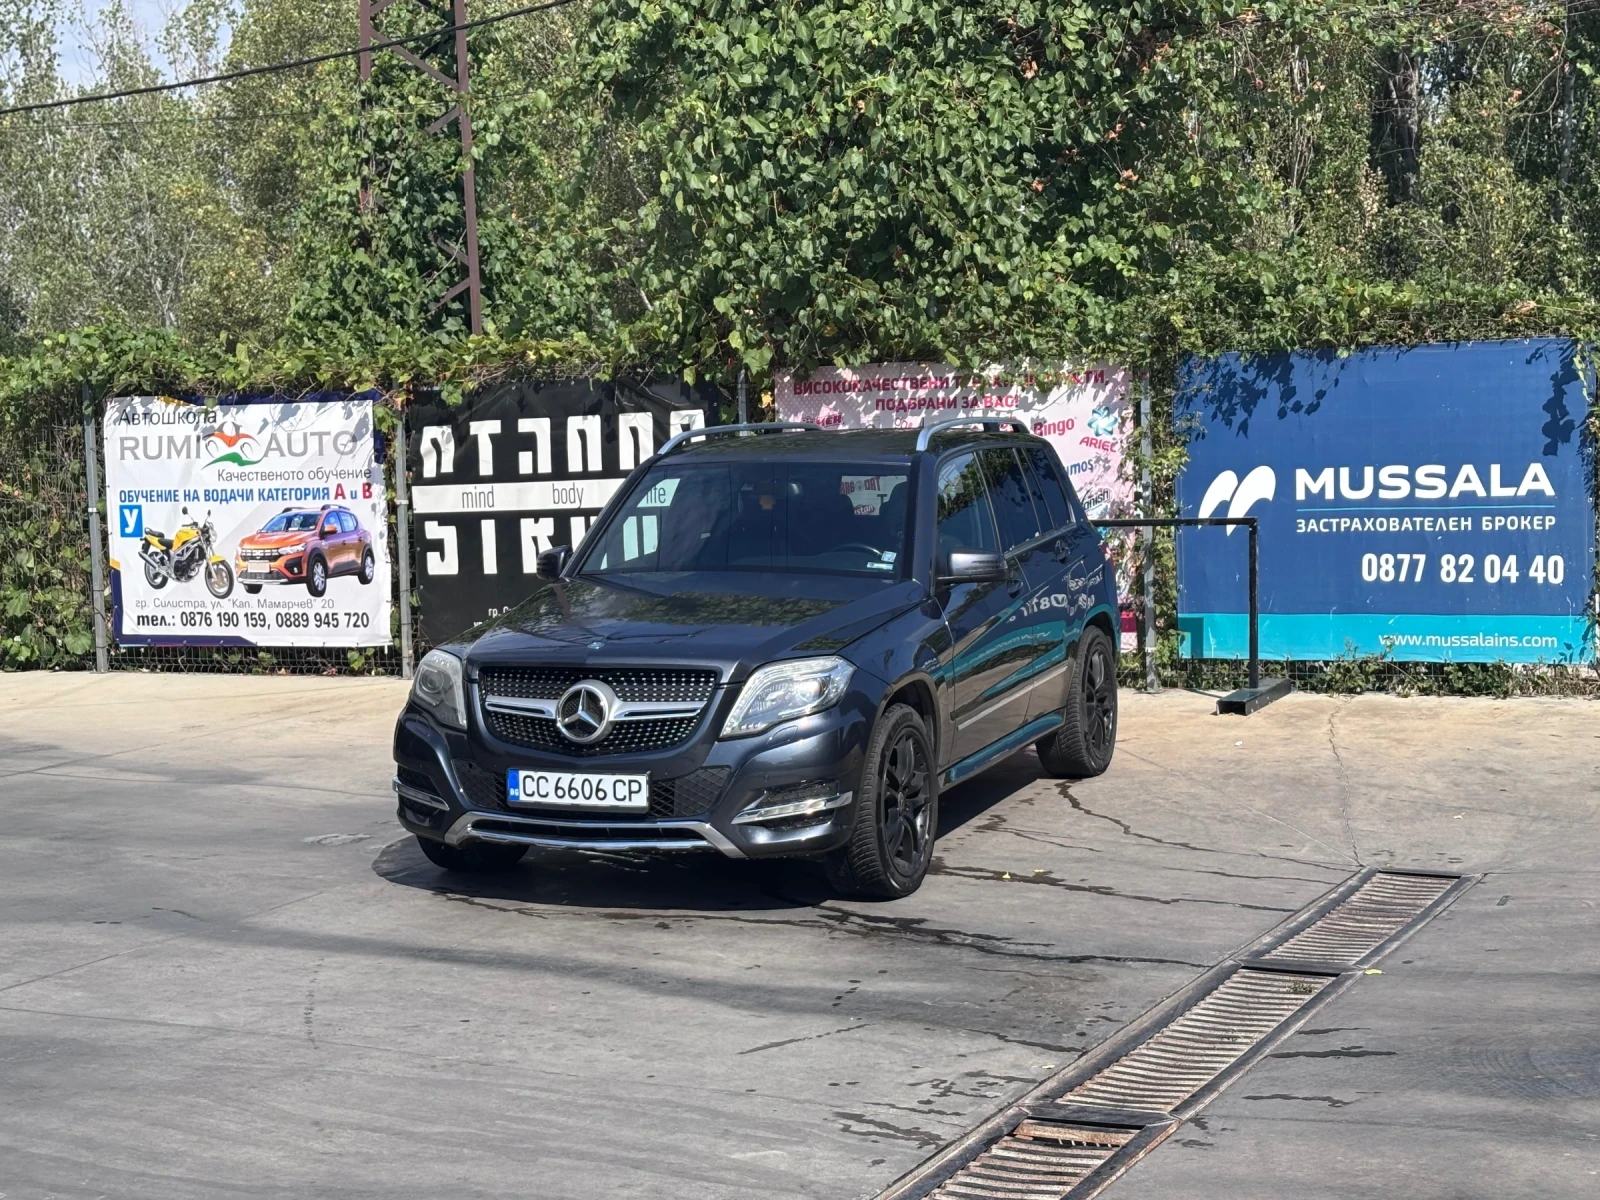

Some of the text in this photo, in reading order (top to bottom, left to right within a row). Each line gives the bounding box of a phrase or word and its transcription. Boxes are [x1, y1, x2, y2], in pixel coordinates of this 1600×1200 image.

[793, 376, 949, 395] ВИСОКОКАЧЕСТВЕНИ
[875, 394, 1020, 412] ПОДБРАНИ ЗА ВАС!
[118, 409, 217, 426] Автошкола
[1033, 418, 1075, 436] Bingo
[119, 430, 357, 461] RUMI AUTO
[1079, 436, 1117, 453] ARIEL
[217, 467, 373, 482] Качественото обучение
[1295, 463, 1555, 500] MUSSALA
[119, 489, 179, 503] ОБУЧЕНИЕ
[184, 489, 200, 502] НА
[204, 488, 254, 504] ВОДАЧИ
[258, 487, 330, 501] КАТЕГОРИЯ
[461, 486, 495, 508] mind
[552, 482, 584, 508] body
[1296, 515, 1556, 533] ЗАСТРАХОВАТЕЛЕН БРОКЕР
[1361, 553, 1564, 584] 0877 82 04 40
[135, 600, 150, 610] гр.
[153, 598, 207, 610] Силистра,
[210, 600, 224, 611] ул.
[320, 599, 335, 609] 20
[136, 611, 370, 630] тел.: 0876 190 159, 0889 945 720
[1378, 632, 1558, 648] www.mussalains.com
[510, 787, 519, 796] BG
[554, 777, 608, 801] 6606
